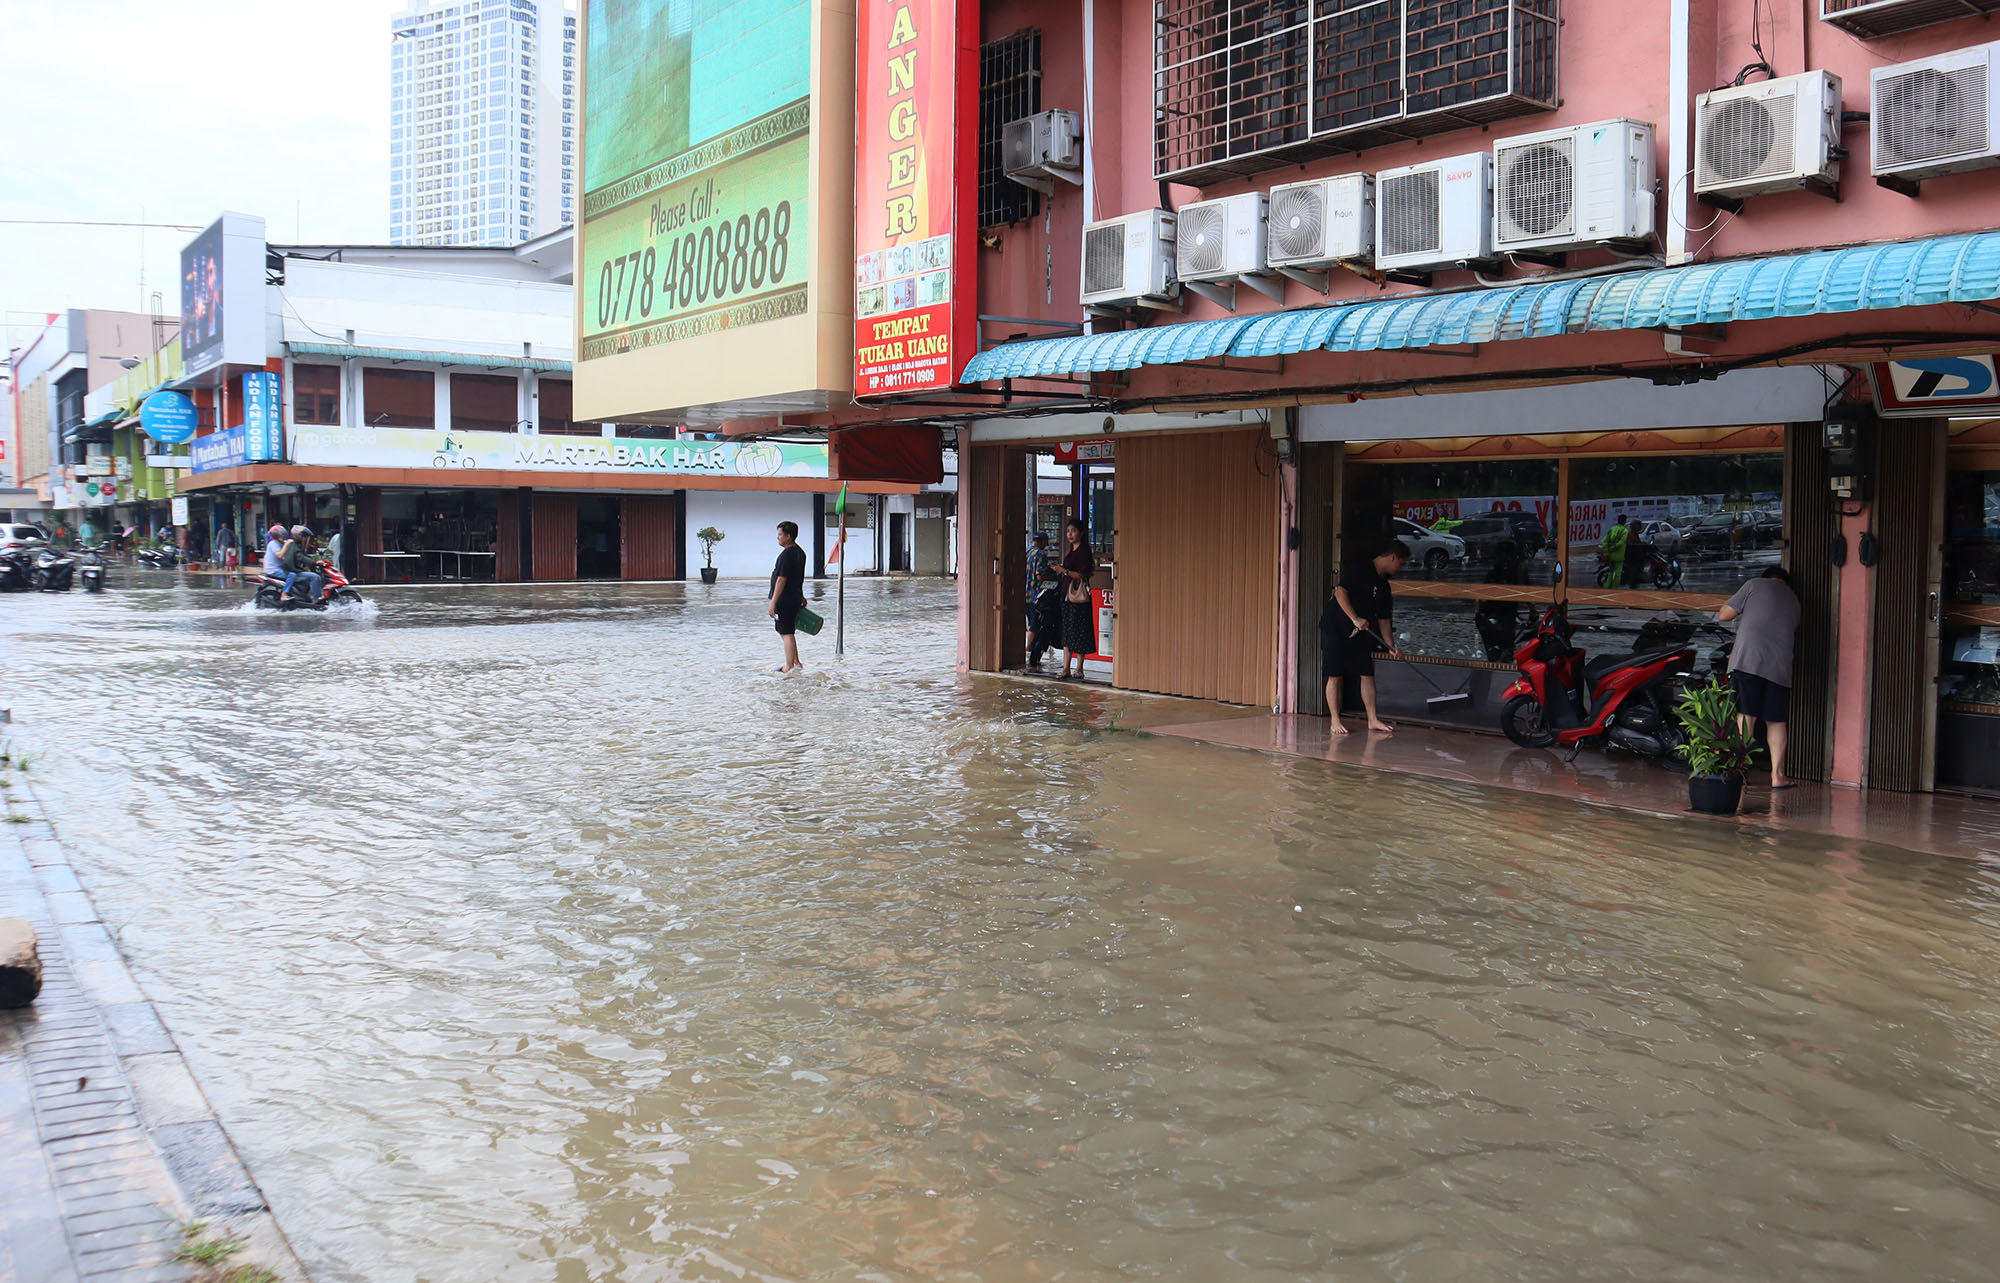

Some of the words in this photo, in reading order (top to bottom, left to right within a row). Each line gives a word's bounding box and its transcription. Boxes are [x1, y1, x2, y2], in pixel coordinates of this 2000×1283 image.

[885, 0, 918, 237] ANGER
[1447, 170, 1473, 182] SANYO
[649, 198, 686, 238] Please
[690, 177, 714, 224] Call
[1335, 209, 1354, 219] AQUA
[598, 246, 656, 329] 0778
[662, 200, 791, 309] 4808888
[872, 313, 931, 341] TEMPAT
[858, 341, 905, 365] TUKAR
[907, 334, 949, 358] UANG
[248, 373, 261, 418] INDIAN
[270, 373, 278, 418] INDIAN
[869, 375, 880, 389] HP
[249, 421, 262, 450] FOOD
[271, 421, 279, 450] FOOD
[320, 433, 377, 448] gofood
[514, 439, 667, 468] MARTABAK
[673, 447, 725, 470] HAR
